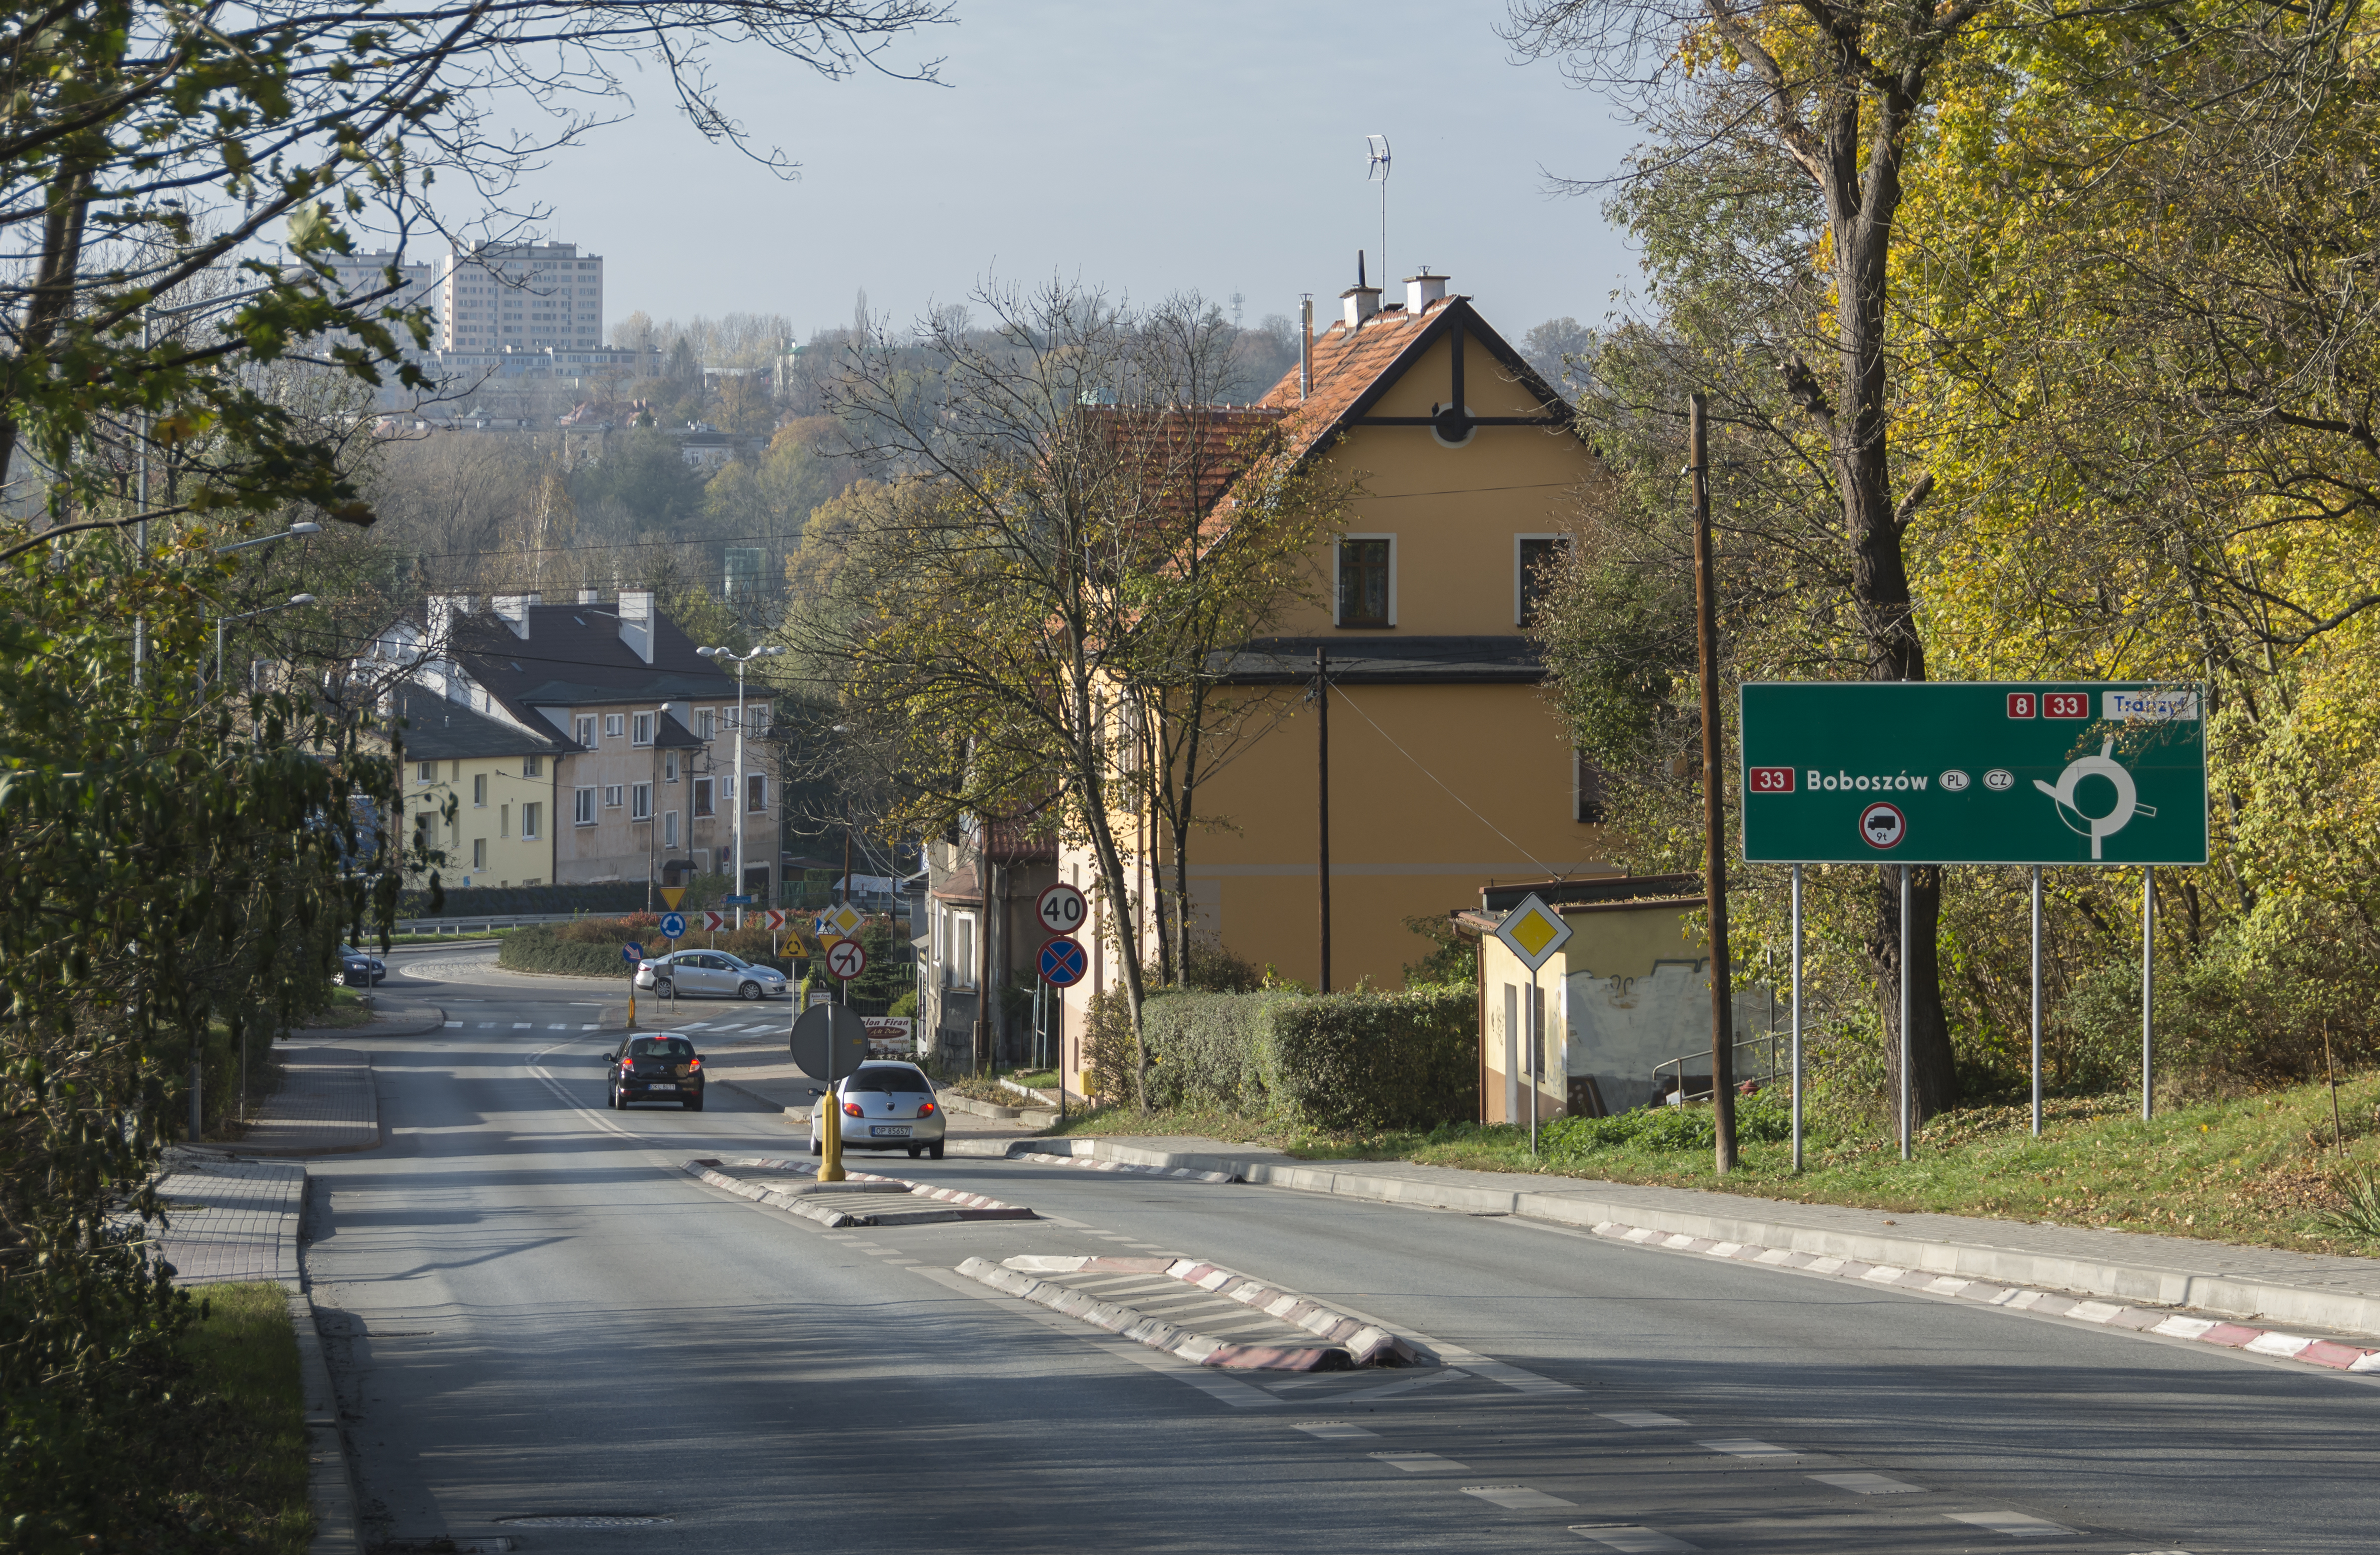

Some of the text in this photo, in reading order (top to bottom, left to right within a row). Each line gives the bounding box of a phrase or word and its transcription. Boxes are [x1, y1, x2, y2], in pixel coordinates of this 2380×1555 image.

[2016, 697, 2028, 714] 8
[2053, 697, 2078, 714] 33
[1760, 770, 2007, 790] 33 Boboszów PL CZ
[1876, 832, 1887, 841] 9t
[1043, 897, 1080, 921] 40
